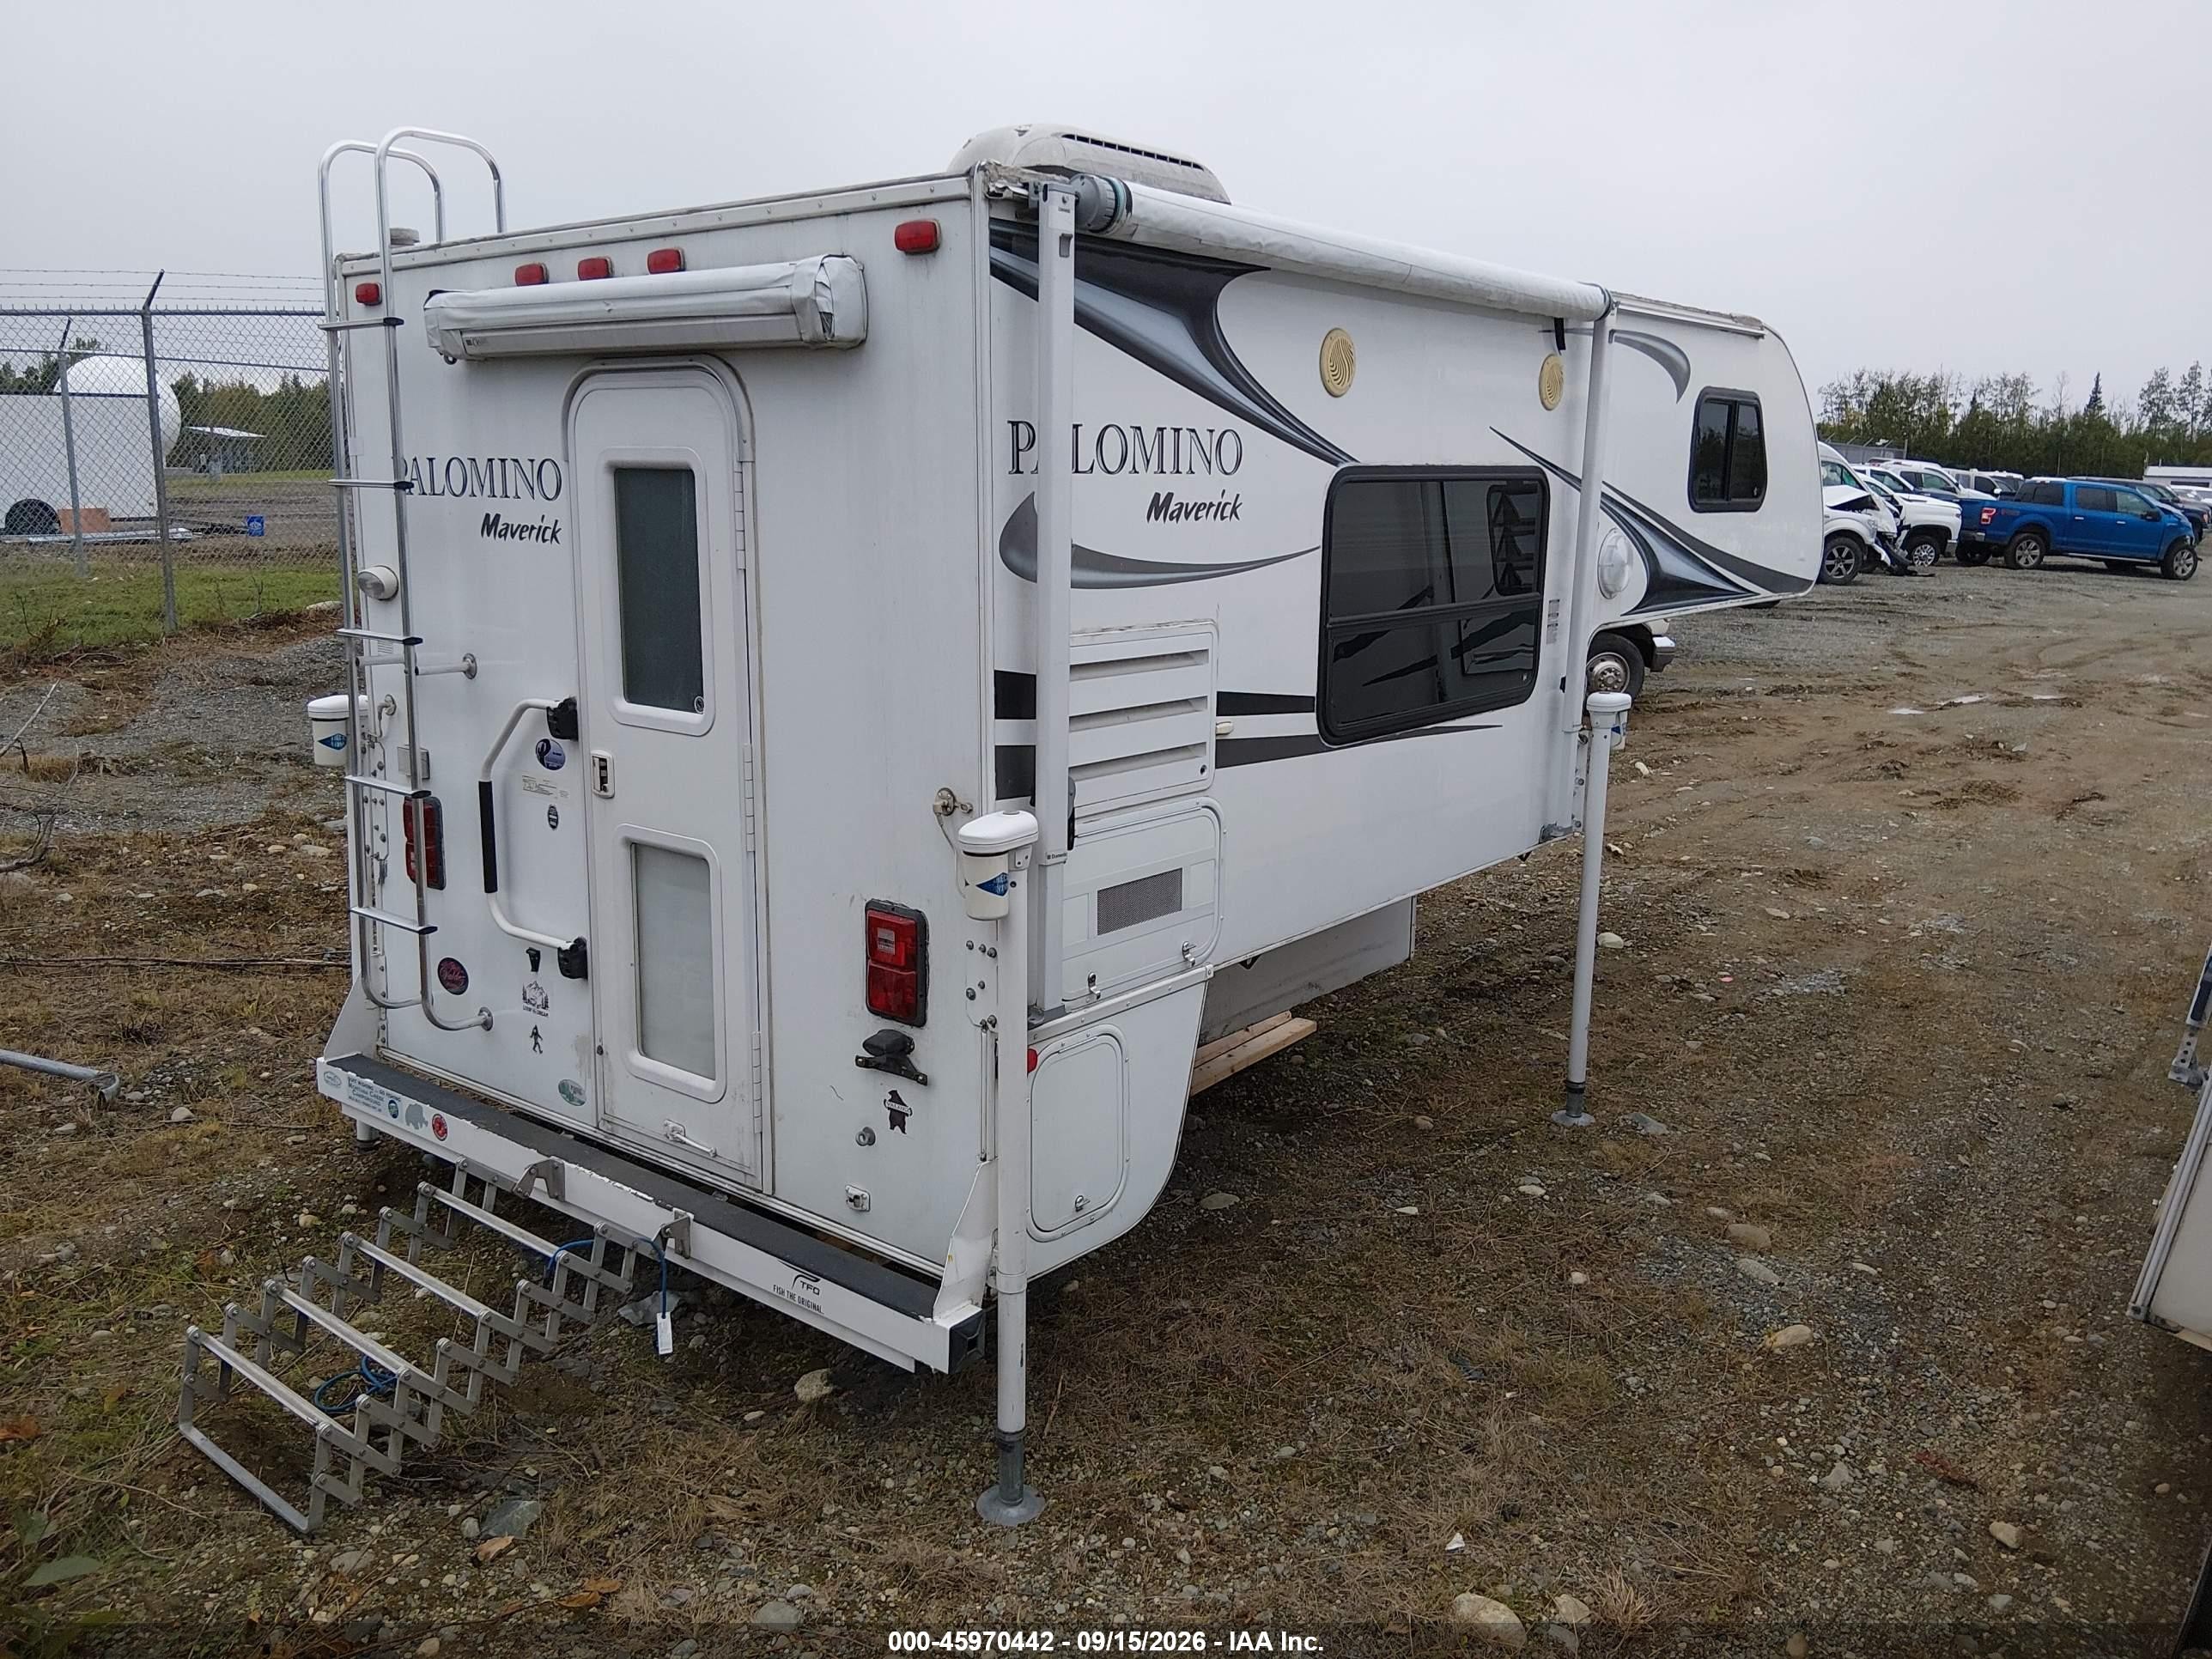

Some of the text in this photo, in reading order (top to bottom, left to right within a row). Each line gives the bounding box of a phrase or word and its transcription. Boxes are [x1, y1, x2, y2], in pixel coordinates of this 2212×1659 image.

[1007, 420, 1243, 476] PLOMINO
[1146, 489, 1243, 524] Maverick
[481, 513, 562, 544] Maverick
[773, 1284, 785, 1297] FISH
[787, 1290, 797, 1302] THE
